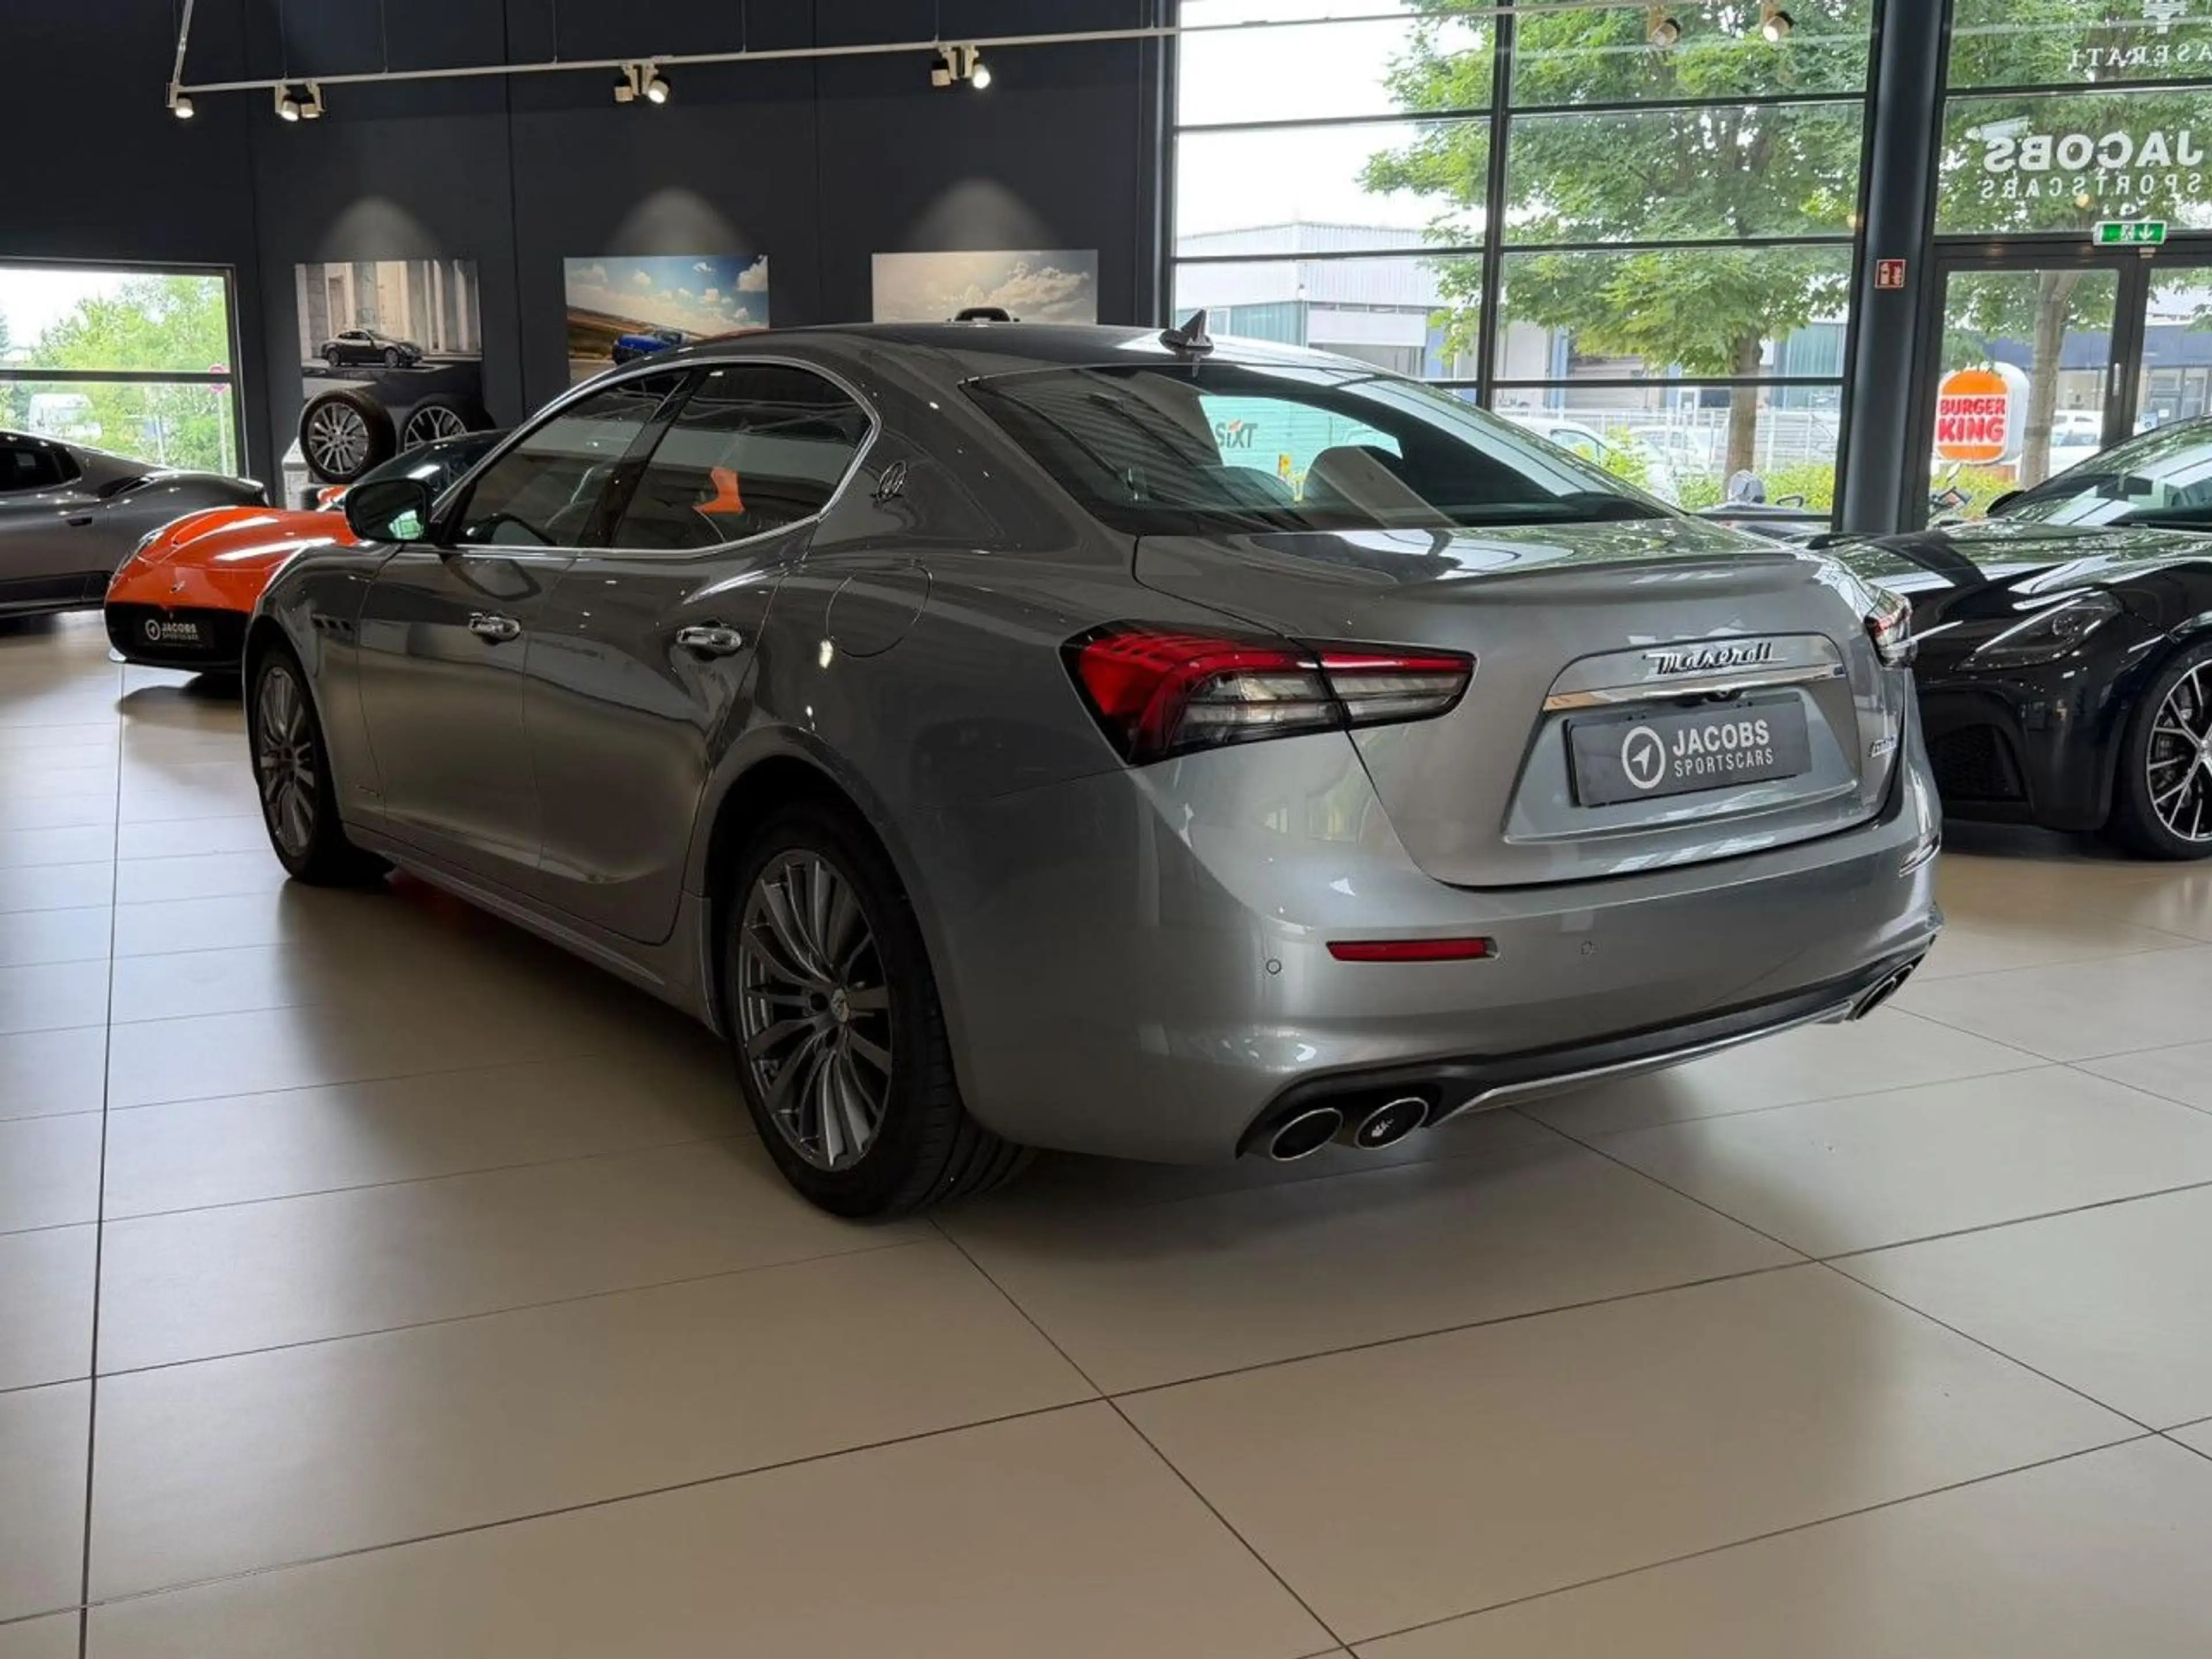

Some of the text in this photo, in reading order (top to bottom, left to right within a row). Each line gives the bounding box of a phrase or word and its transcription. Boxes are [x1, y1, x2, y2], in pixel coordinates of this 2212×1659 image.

[1940, 397, 2006, 415] BURGER
[1938, 416, 2005, 443] KING
[1672, 718, 1770, 757] JACOBS
[1673, 748, 1774, 778] SPORTSCARS
